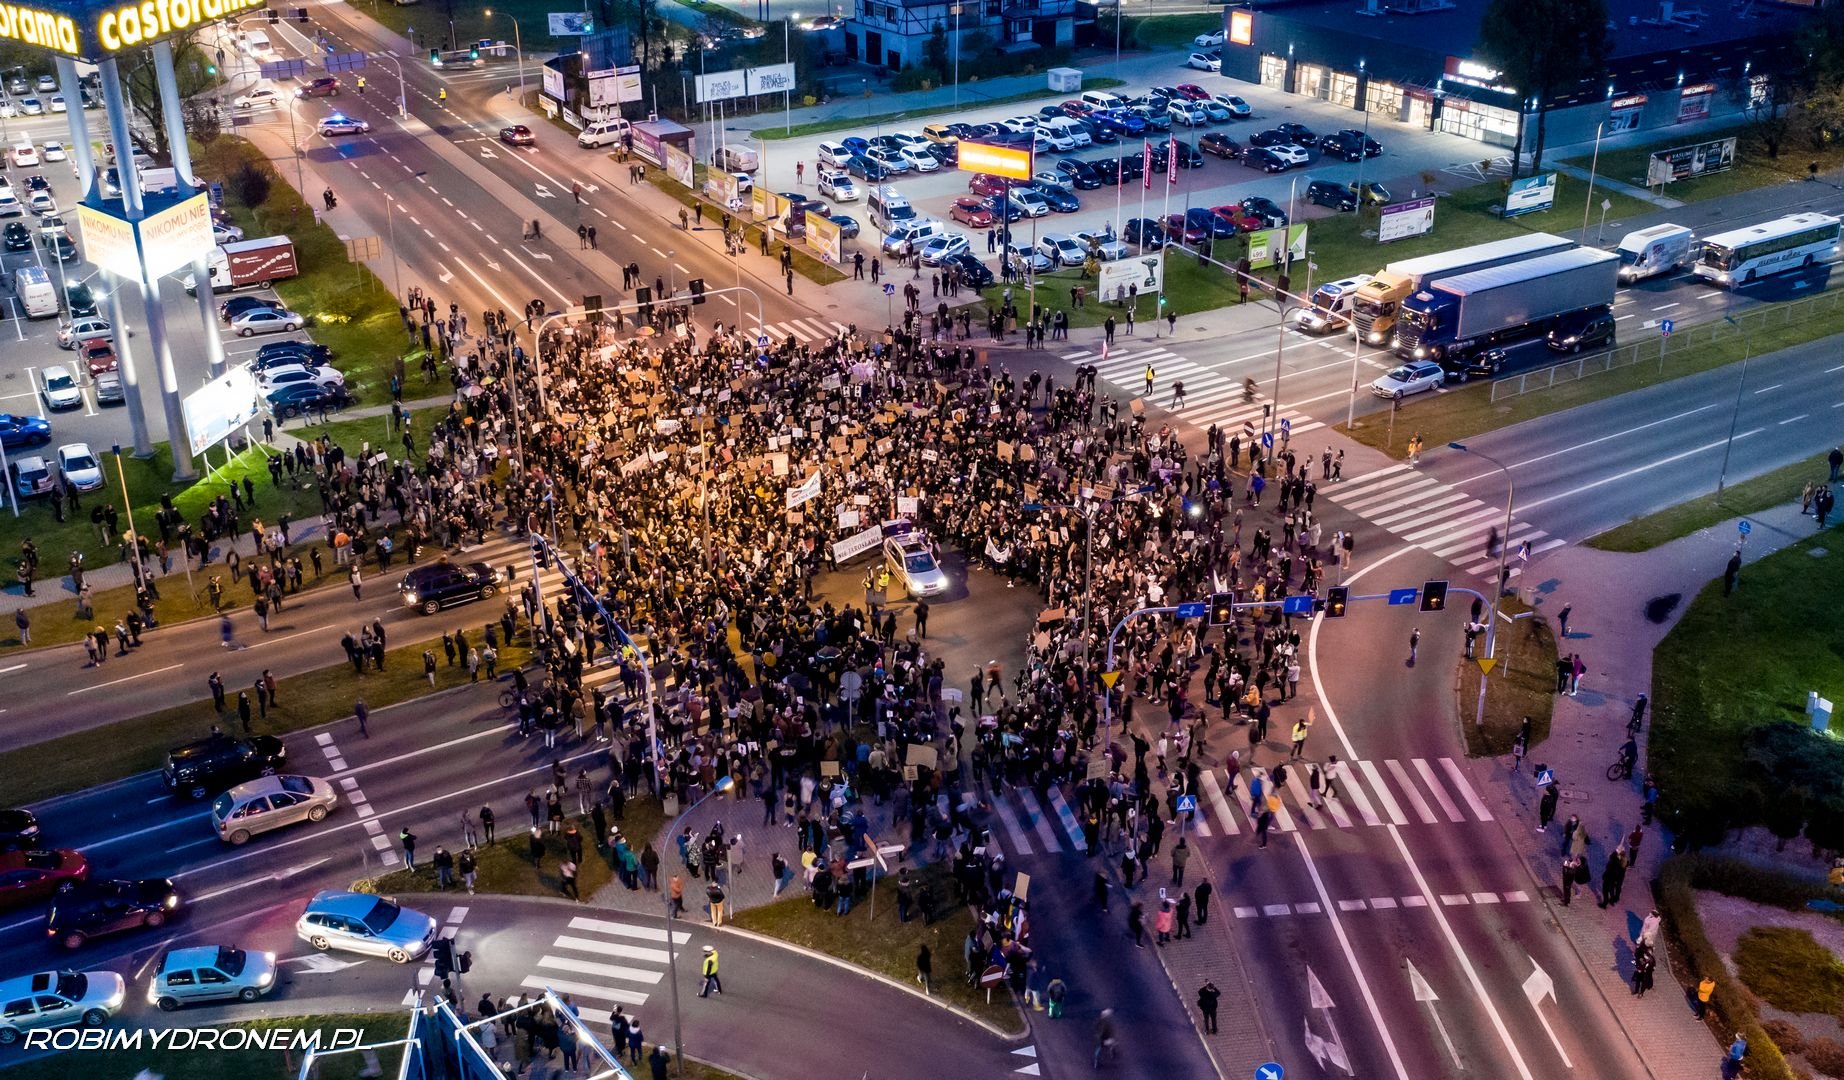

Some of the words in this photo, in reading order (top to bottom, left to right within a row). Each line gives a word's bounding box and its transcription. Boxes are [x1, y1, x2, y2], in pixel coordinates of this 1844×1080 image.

[82, 215, 118, 239] NIKOMU
[146, 212, 188, 240] NIKOMU
[189, 203, 207, 219] NIE
